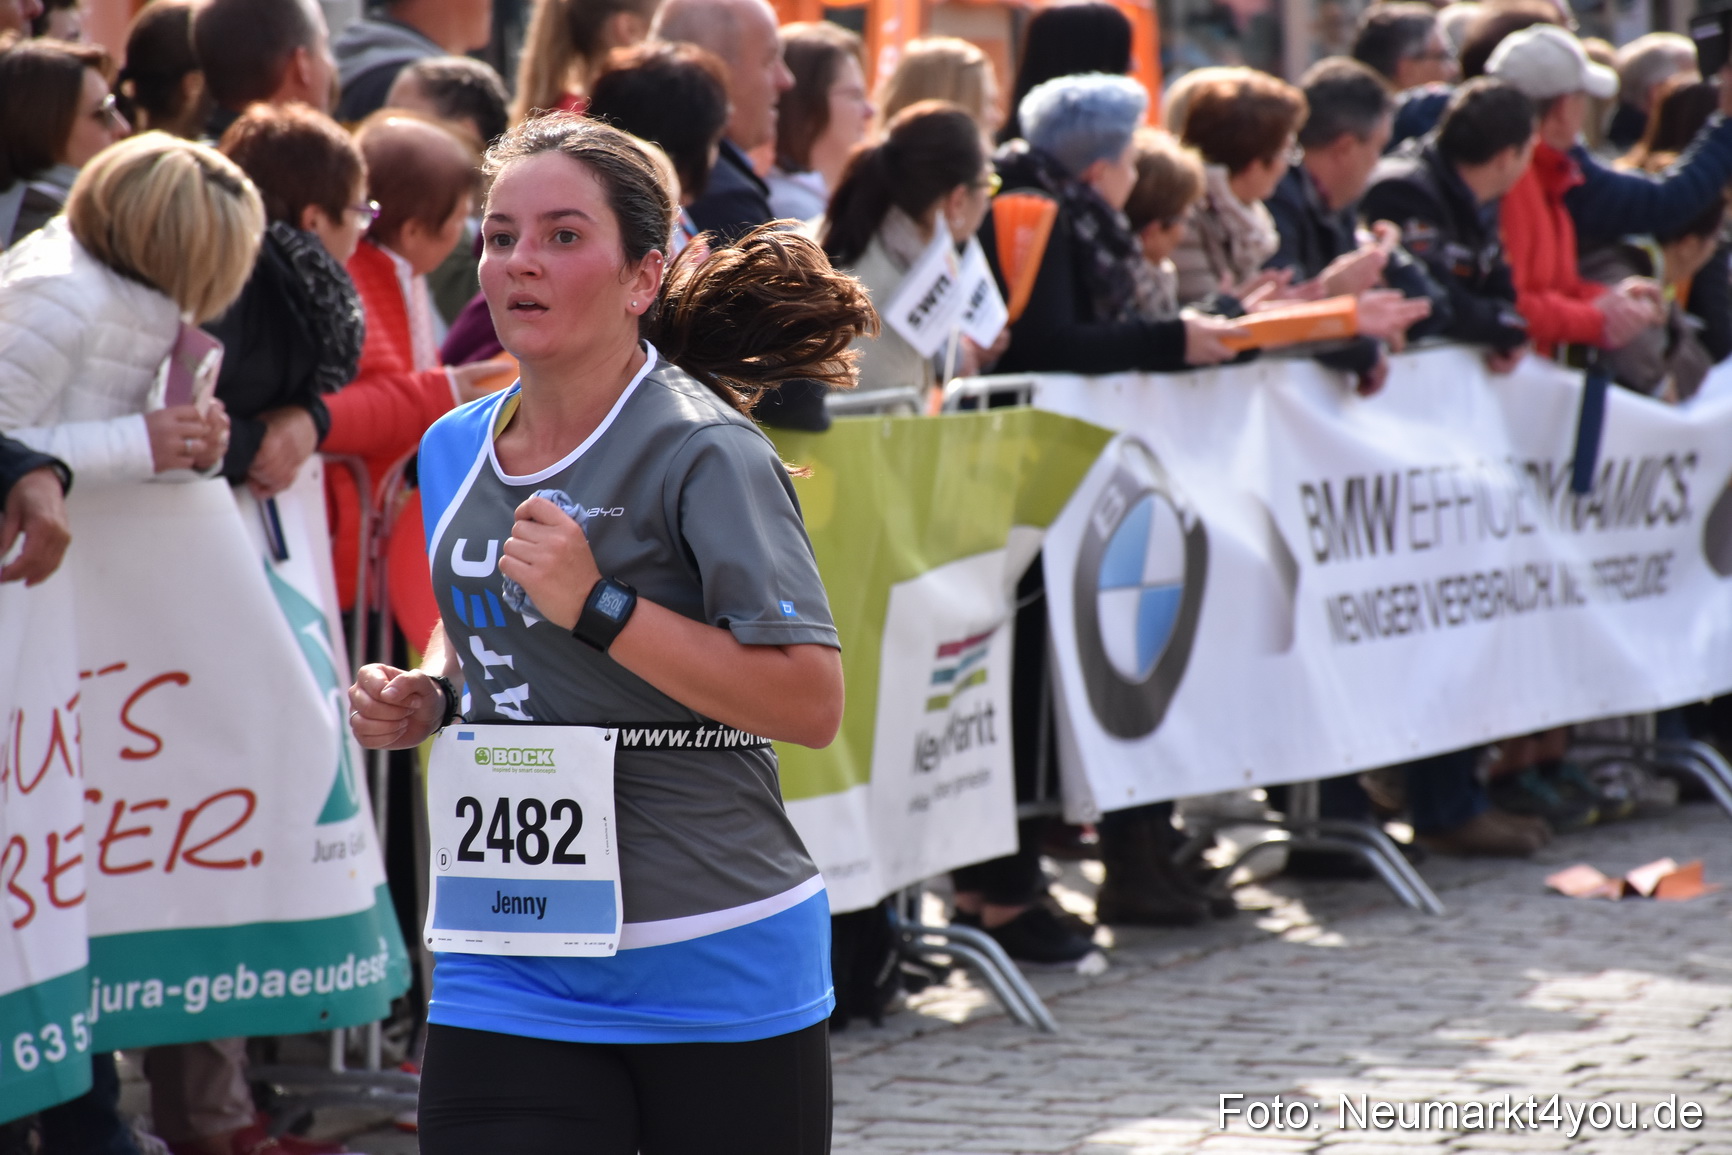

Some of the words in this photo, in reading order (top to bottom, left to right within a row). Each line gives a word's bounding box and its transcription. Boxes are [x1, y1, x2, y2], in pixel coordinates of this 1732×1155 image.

[1300, 473, 1399, 565] BMW
[492, 747, 556, 767] BOCK
[455, 796, 587, 866] 2482
[312, 838, 347, 863] Jura
[441, 853, 447, 866] D
[491, 890, 548, 920] Jenny
